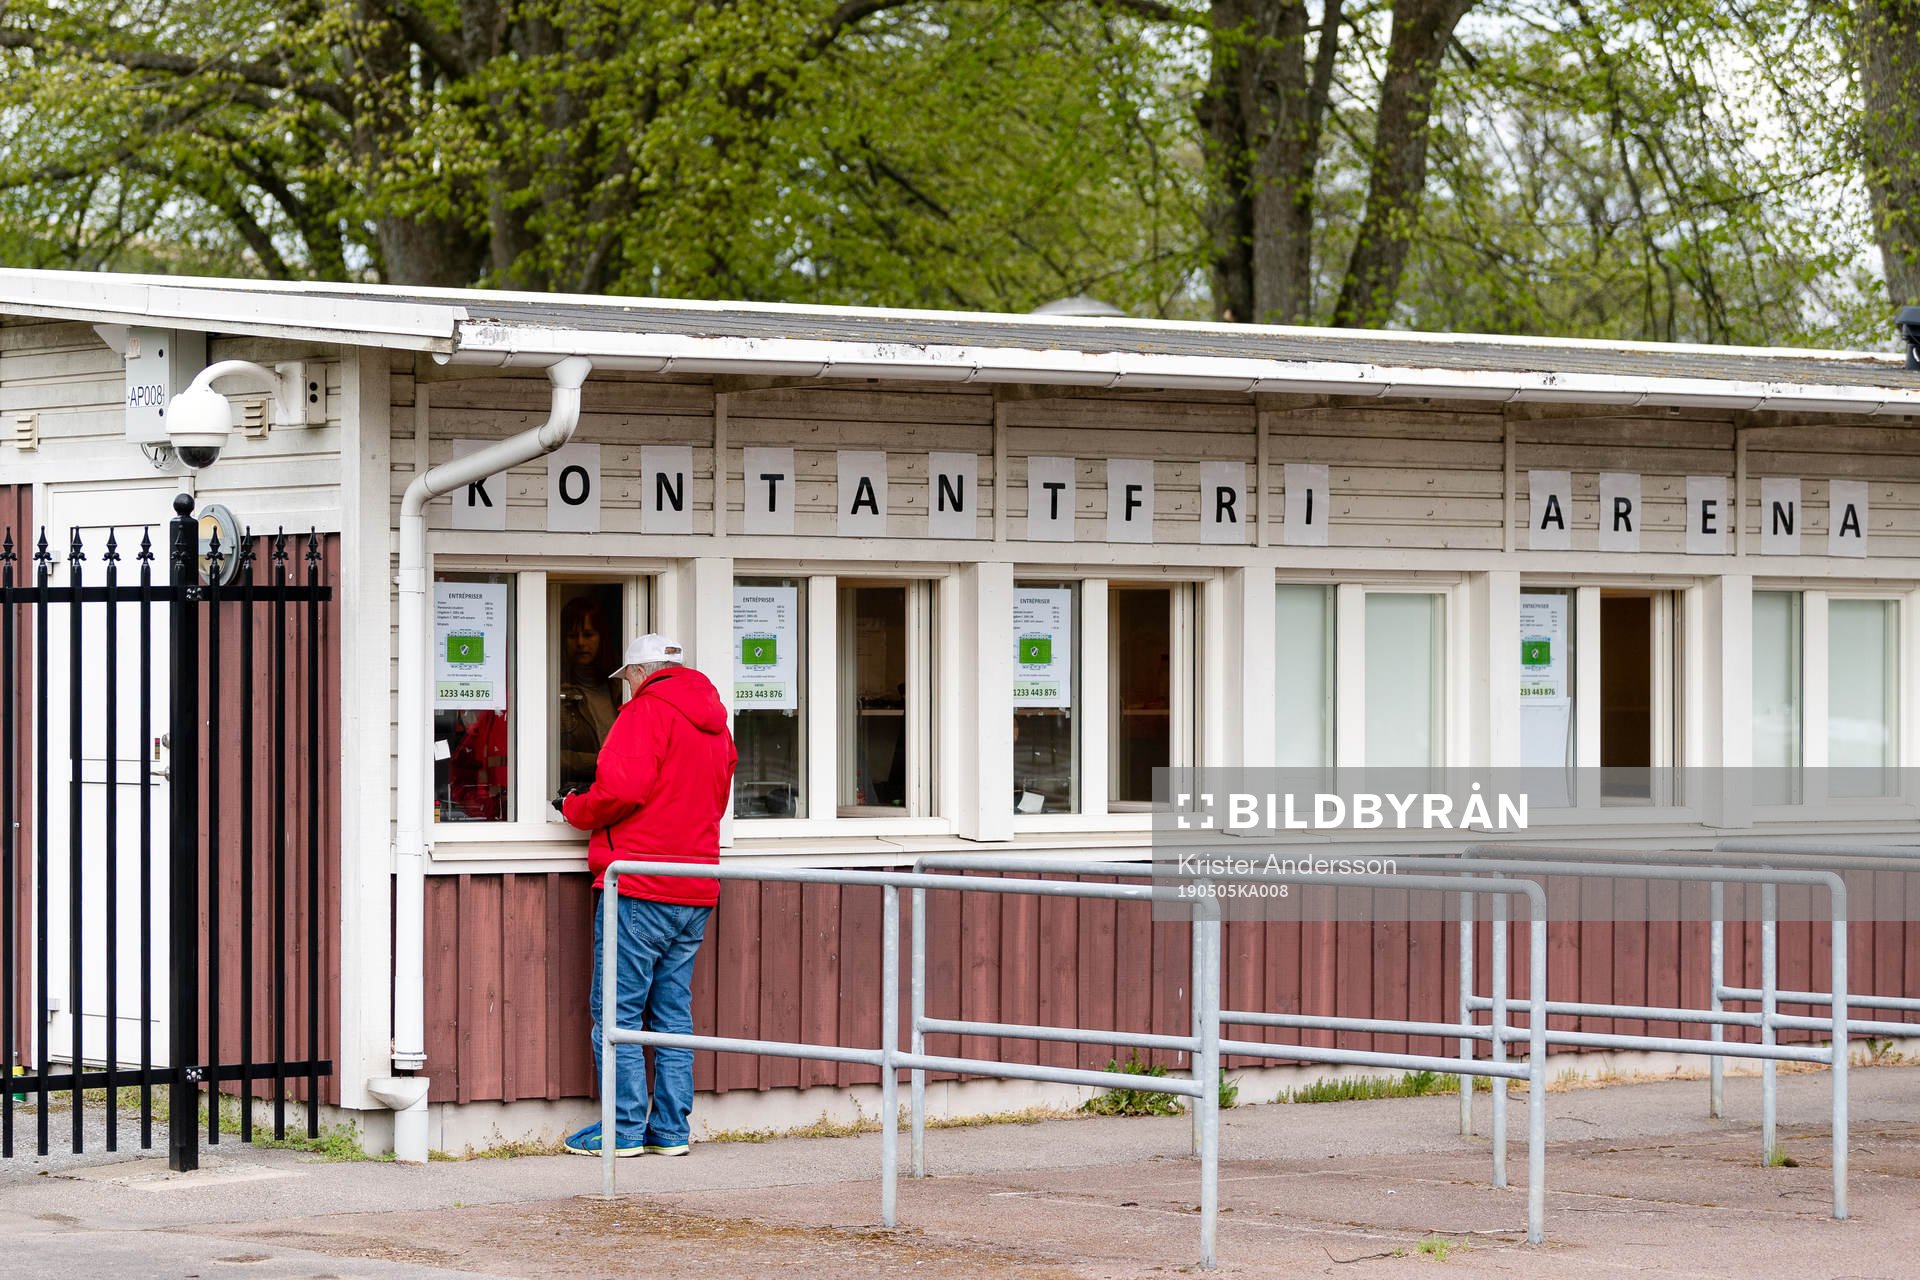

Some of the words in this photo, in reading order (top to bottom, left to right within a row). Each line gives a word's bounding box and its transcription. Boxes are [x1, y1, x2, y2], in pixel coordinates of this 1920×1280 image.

[130, 385, 163, 406] AP008
[1540, 494, 1862, 538] ARENA
[448, 592, 483, 600] ENTRÉPRISER
[440, 689, 458, 698] 1233
[460, 689, 474, 698] 443
[476, 689, 490, 698] 876
[736, 690, 753, 698] 1233
[754, 690, 768, 698] 443
[769, 690, 783, 698] 876
[1013, 689, 1029, 697] 1233
[1030, 689, 1043, 697] 443
[1044, 688, 1057, 697] 876
[1520, 688, 1531, 696] 233
